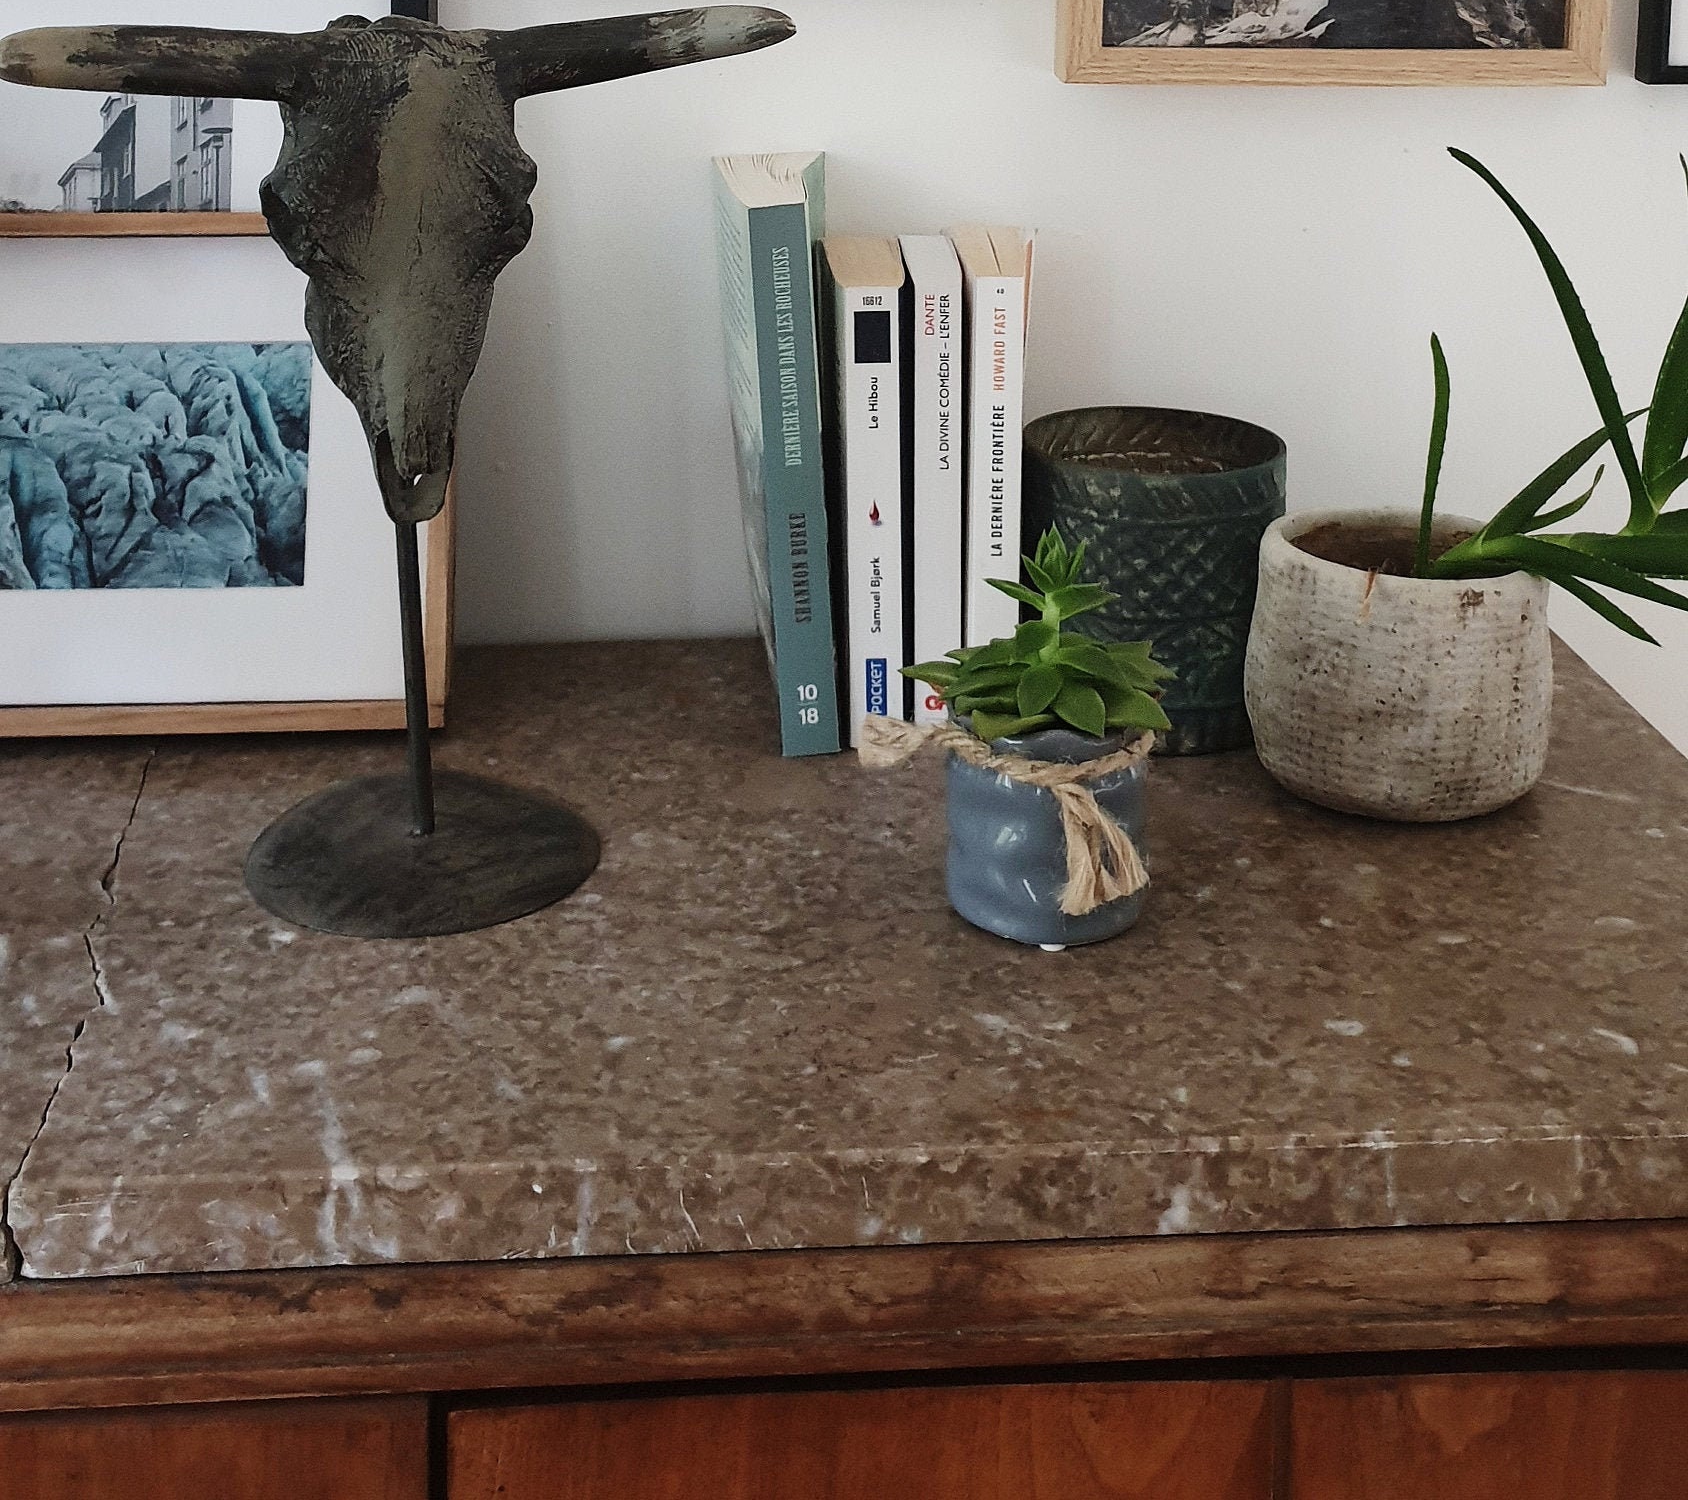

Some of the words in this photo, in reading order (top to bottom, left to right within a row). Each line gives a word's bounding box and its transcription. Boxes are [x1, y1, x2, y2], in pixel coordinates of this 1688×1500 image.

[772, 245, 794, 312] ROCHEUSES
[862, 295, 883, 306] 16612
[924, 294, 935, 336] DANTE
[939, 294, 950, 339] L'ENFER
[994, 307, 1007, 335] FAST
[776, 313, 795, 334] LES
[778, 335, 795, 365] DANS
[993, 340, 1006, 391] HOWARD
[779, 368, 799, 408] SAISON
[868, 376, 878, 412] Hibou
[937, 352, 950, 409] COMÉDIE
[781, 410, 802, 467] DERNIÈRE
[868, 415, 879, 429] Le
[939, 410, 950, 452] DIVINE
[989, 404, 1005, 472] FRONTIÈRE
[939, 455, 949, 470] LA
[988, 477, 1004, 538] DERNIÈRE
[788, 512, 809, 556] BURKE
[990, 543, 1003, 557] LA
[869, 556, 883, 588] Bjørk
[790, 562, 812, 624] SHANNON
[870, 591, 882, 634] Samuel
[796, 683, 819, 701] 10
[798, 707, 820, 725] 18
